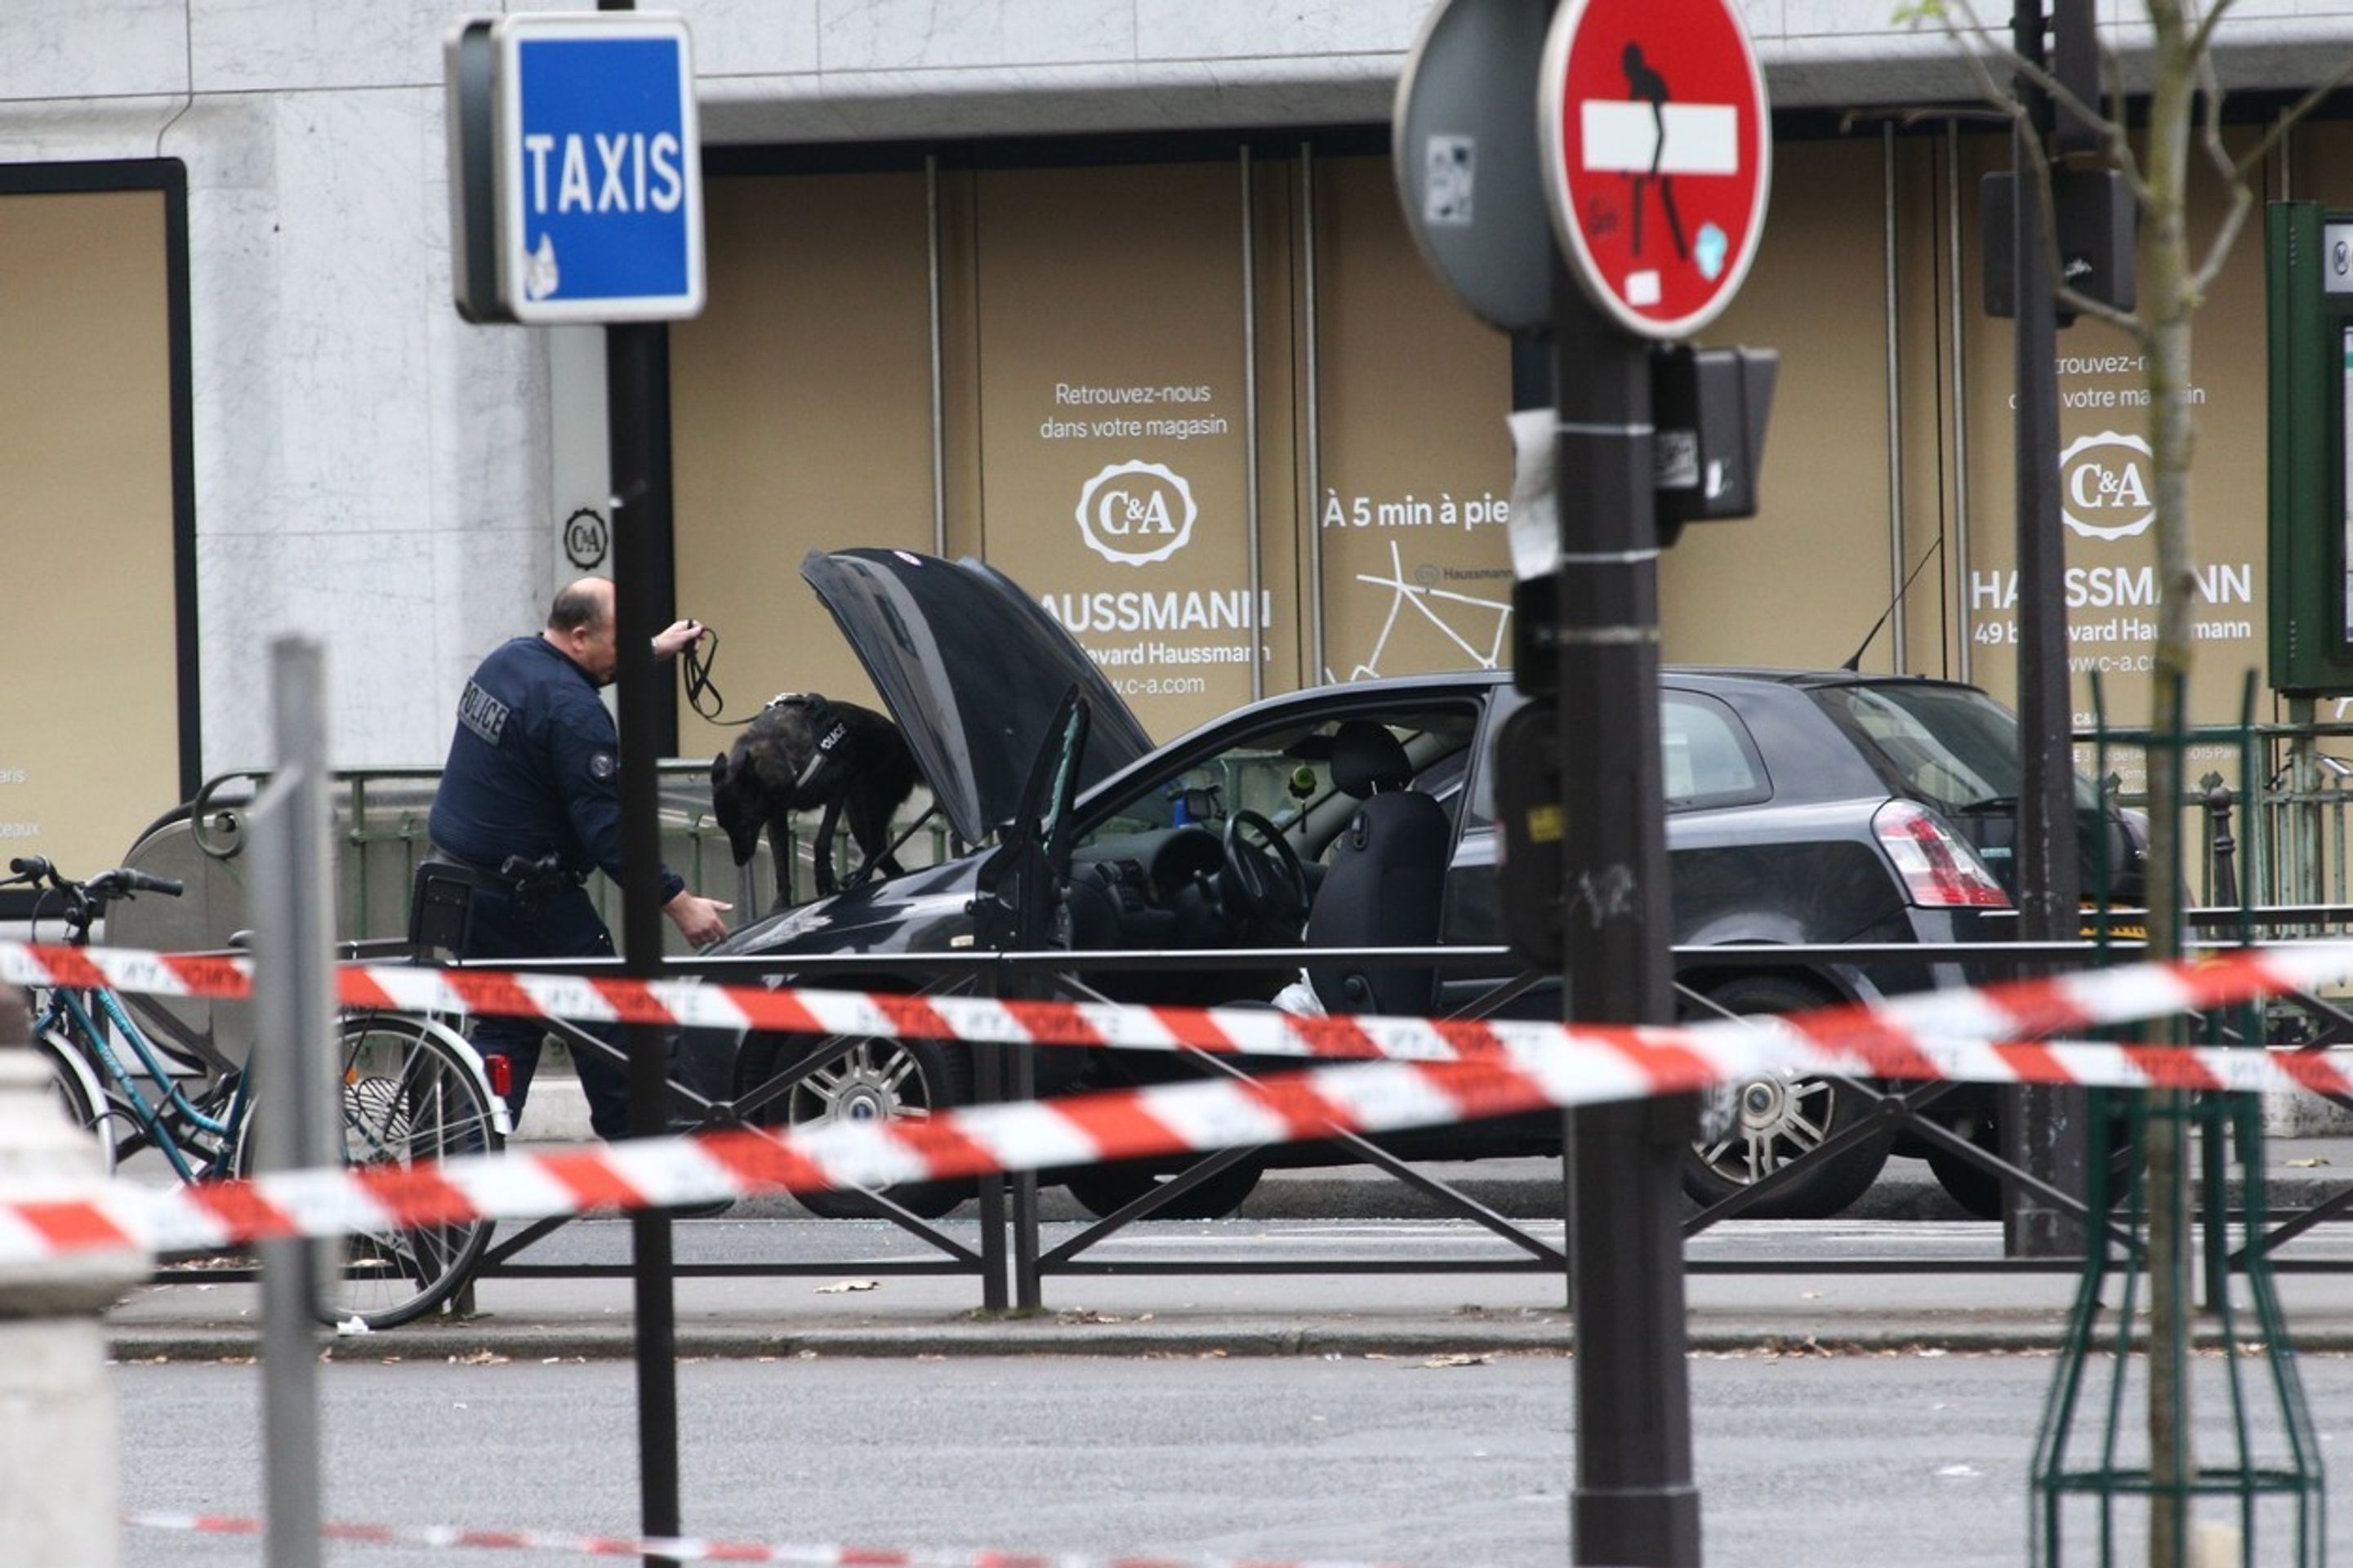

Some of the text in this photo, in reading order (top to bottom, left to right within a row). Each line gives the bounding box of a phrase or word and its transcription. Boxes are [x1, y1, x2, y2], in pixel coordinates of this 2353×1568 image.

[524, 131, 683, 215] TAXIS
[1055, 383, 1211, 404] Retrouvez-nous
[2064, 387, 2115, 408] votre
[1041, 414, 1228, 439] dans votre magasin
[2070, 462, 2151, 508] C&A
[1099, 490, 1175, 535] C&A
[1323, 488, 1347, 528] À
[1353, 497, 1371, 527] 5
[1379, 494, 1433, 526] min
[1440, 492, 1457, 524] à
[1972, 564, 2252, 610] HASSMNN
[1039, 590, 1272, 634] AUSSMANN
[1974, 623, 2002, 644] 49
[2122, 618, 2252, 642] Haumann
[458, 679, 508, 737] POLICE
[0, 765, 27, 784] aris
